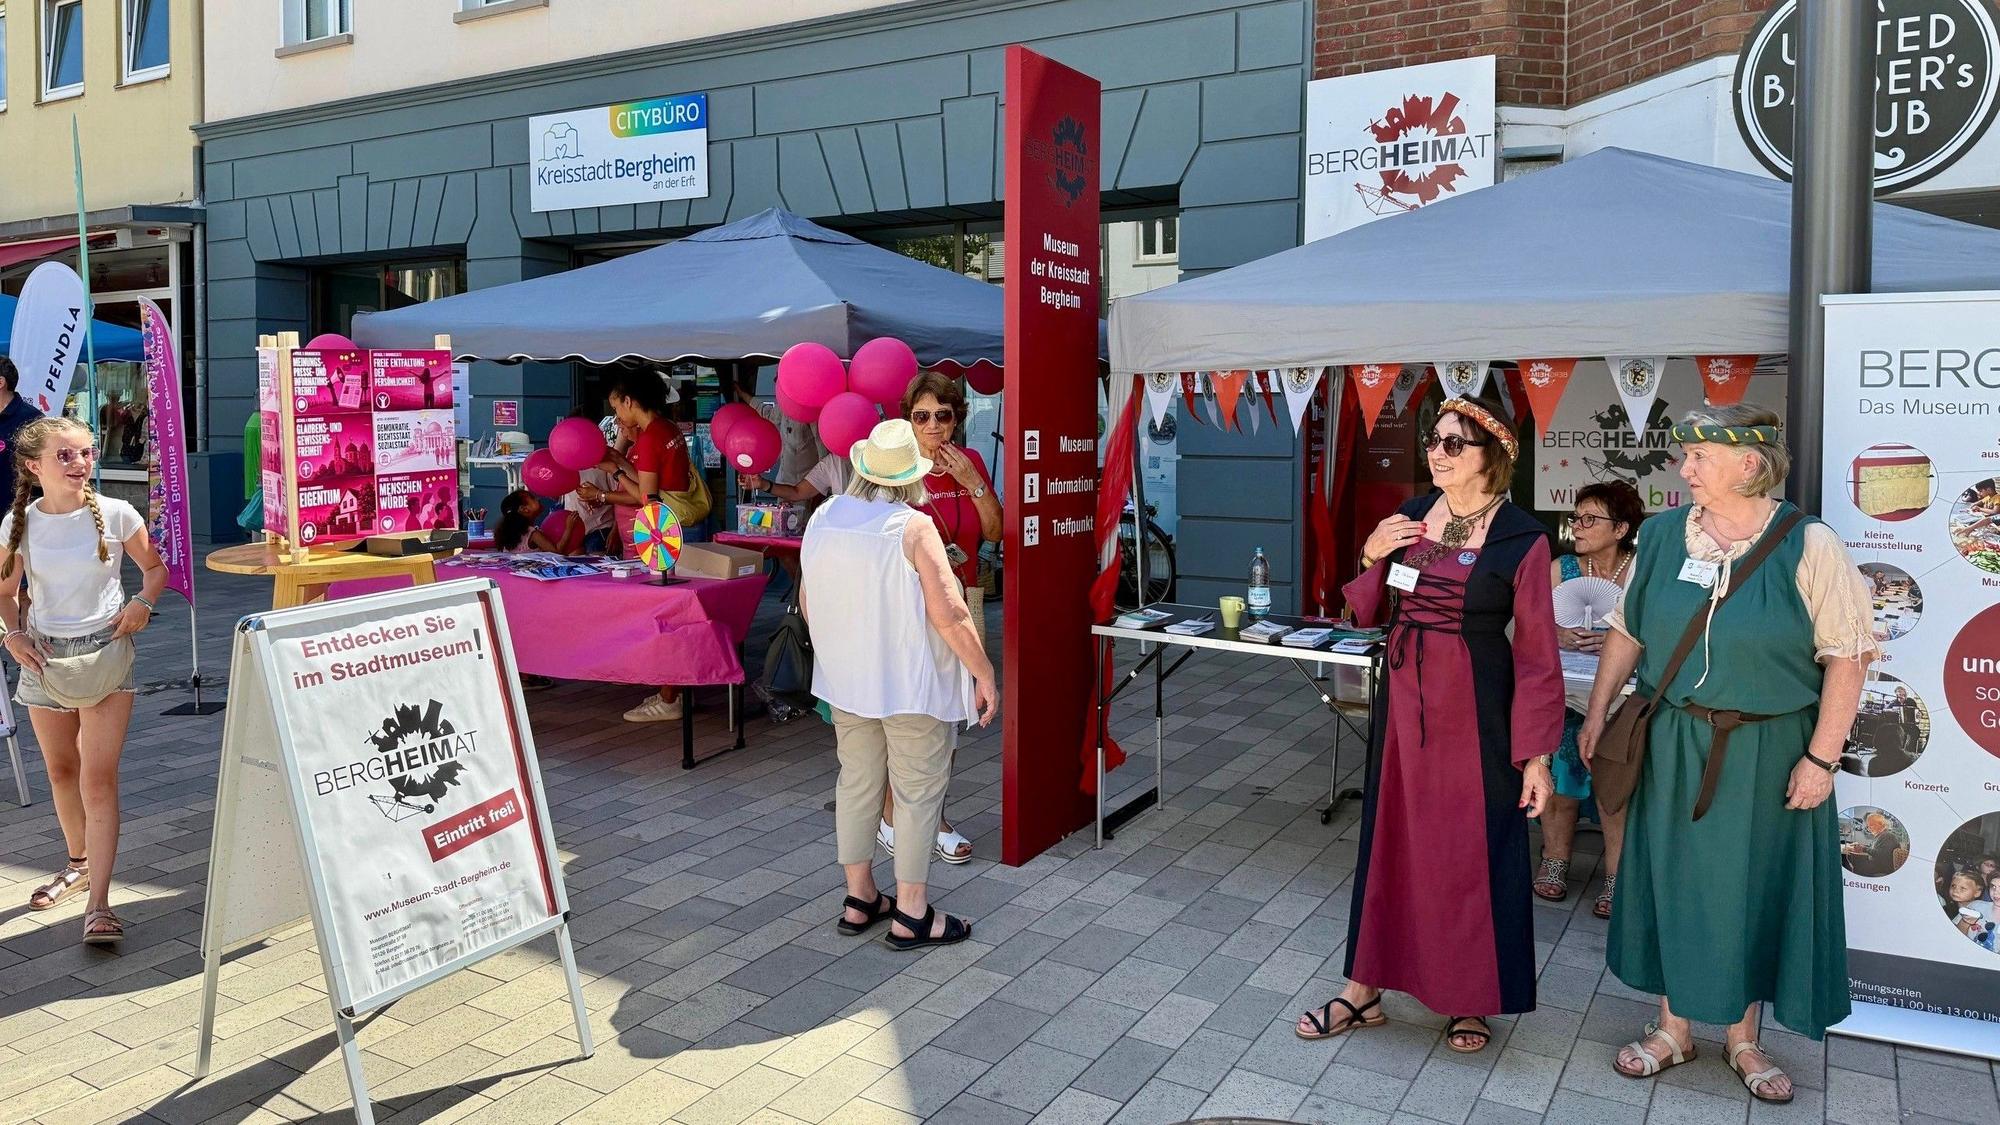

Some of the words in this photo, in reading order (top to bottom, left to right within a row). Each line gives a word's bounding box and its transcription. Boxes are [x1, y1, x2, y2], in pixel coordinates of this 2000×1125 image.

[1782, 13, 1956, 66] UTED
[1763, 53, 1974, 109] BER's
[616, 101, 700, 131] CITYBÜRO
[1308, 133, 1492, 176] BERGHEIMAT
[653, 180, 664, 190] an
[664, 178, 679, 189] der
[681, 175, 696, 188] Erft
[1043, 232, 1079, 258] Museum
[1030, 257, 1046, 276] der
[1048, 260, 1090, 285] Kreisstadt
[1040, 285, 1081, 310] Bergheim
[45, 306, 81, 392] PENDLA
[1859, 398, 1895, 415] Das
[1903, 398, 1990, 415] Museum
[1059, 435, 1094, 453] Museum
[379, 480, 422, 496] MENSCHEN
[1047, 475, 1094, 495] Information
[1550, 484, 1577, 504] wi
[299, 488, 341, 508] EIGENTUM
[380, 494, 409, 510] WÜRDE
[1052, 515, 1094, 537] Treffpunkt
[1864, 530, 1895, 540] kleine
[1844, 540, 1923, 553] auerausstellung
[300, 621, 420, 659] Entdecken
[423, 614, 456, 635] Sie
[293, 670, 324, 690] im
[1980, 709, 2000, 729] G
[314, 730, 478, 797] BERGHEIMAT
[1904, 780, 1950, 793] Konzerte
[433, 814, 487, 849] Eintritt
[489, 800, 516, 823] frei!
[363, 860, 512, 922] www.Museum-Stadt-Bergheim.de
[1843, 877, 1891, 892] Lesungen
[1893, 998, 1924, 1011] 11.00
[1927, 1003, 1943, 1014] bis
[1947, 1006, 1980, 1020] 13.00
